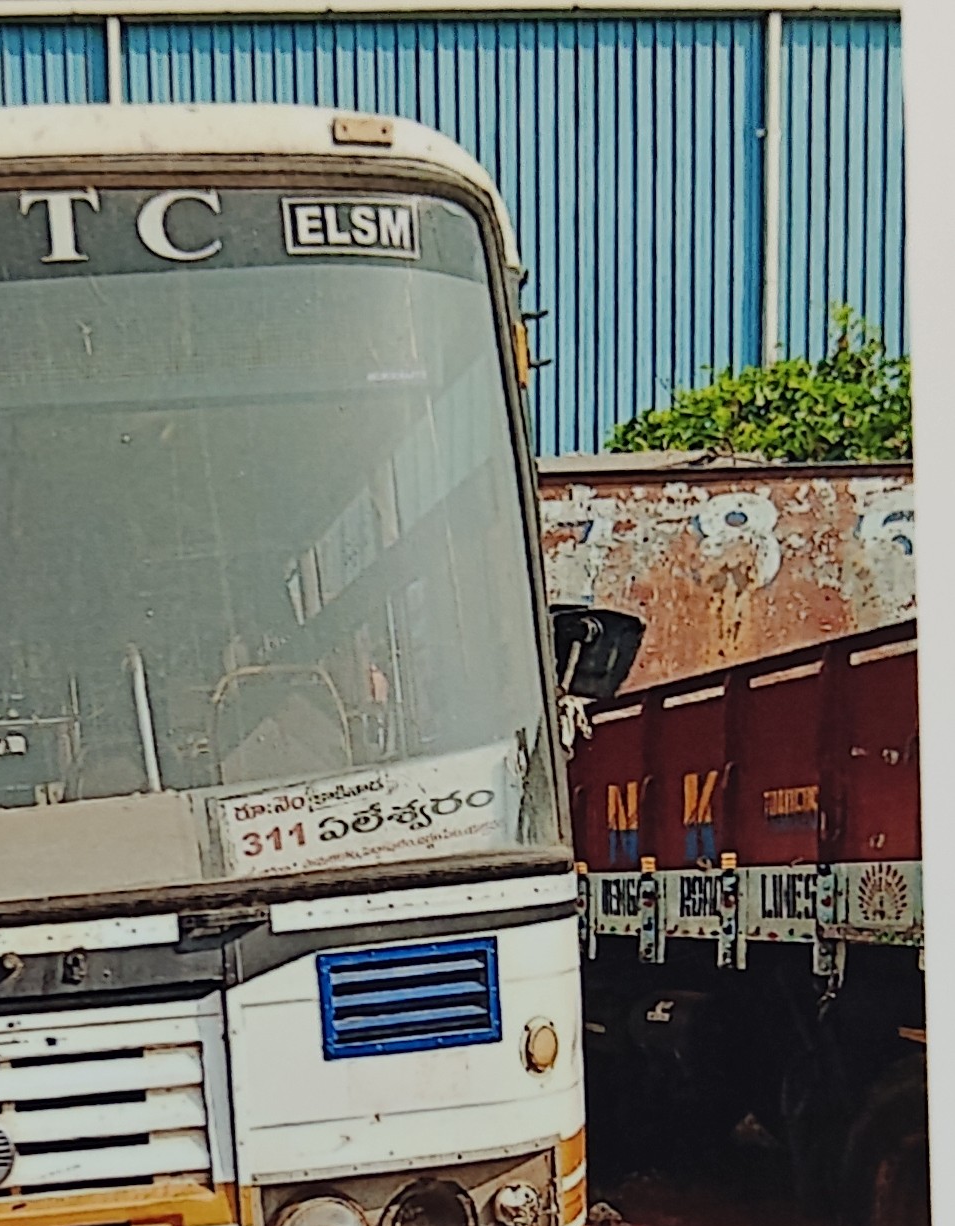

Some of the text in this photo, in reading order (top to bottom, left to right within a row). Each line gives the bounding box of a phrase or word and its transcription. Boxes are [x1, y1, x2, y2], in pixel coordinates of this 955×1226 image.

[296, 202, 413, 250] ELSM
[242, 822, 306, 857] 311
[317, 788, 496, 843] ఏలేశ్వరం
